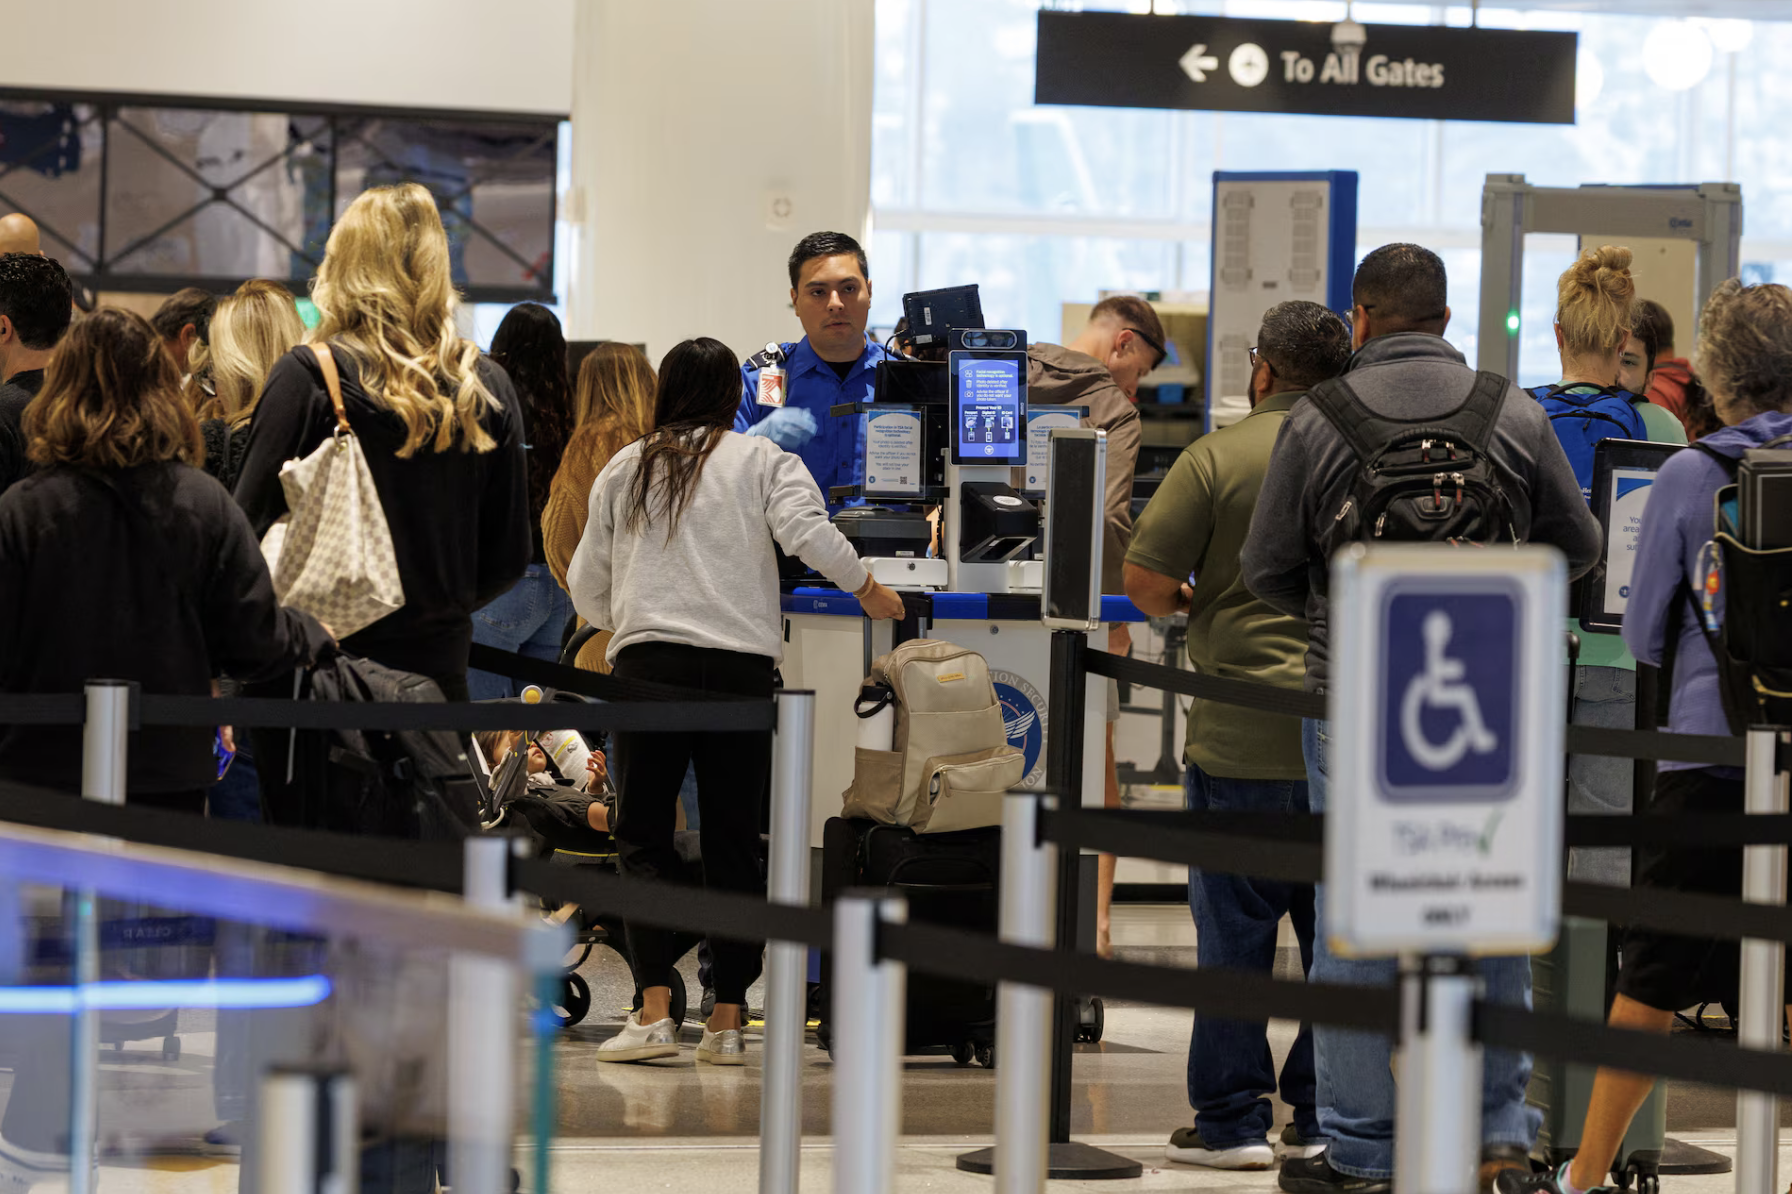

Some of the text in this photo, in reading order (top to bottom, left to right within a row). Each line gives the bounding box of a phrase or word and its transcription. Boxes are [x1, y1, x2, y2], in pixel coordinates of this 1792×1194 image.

[1280, 51, 1445, 88] To All Gates
